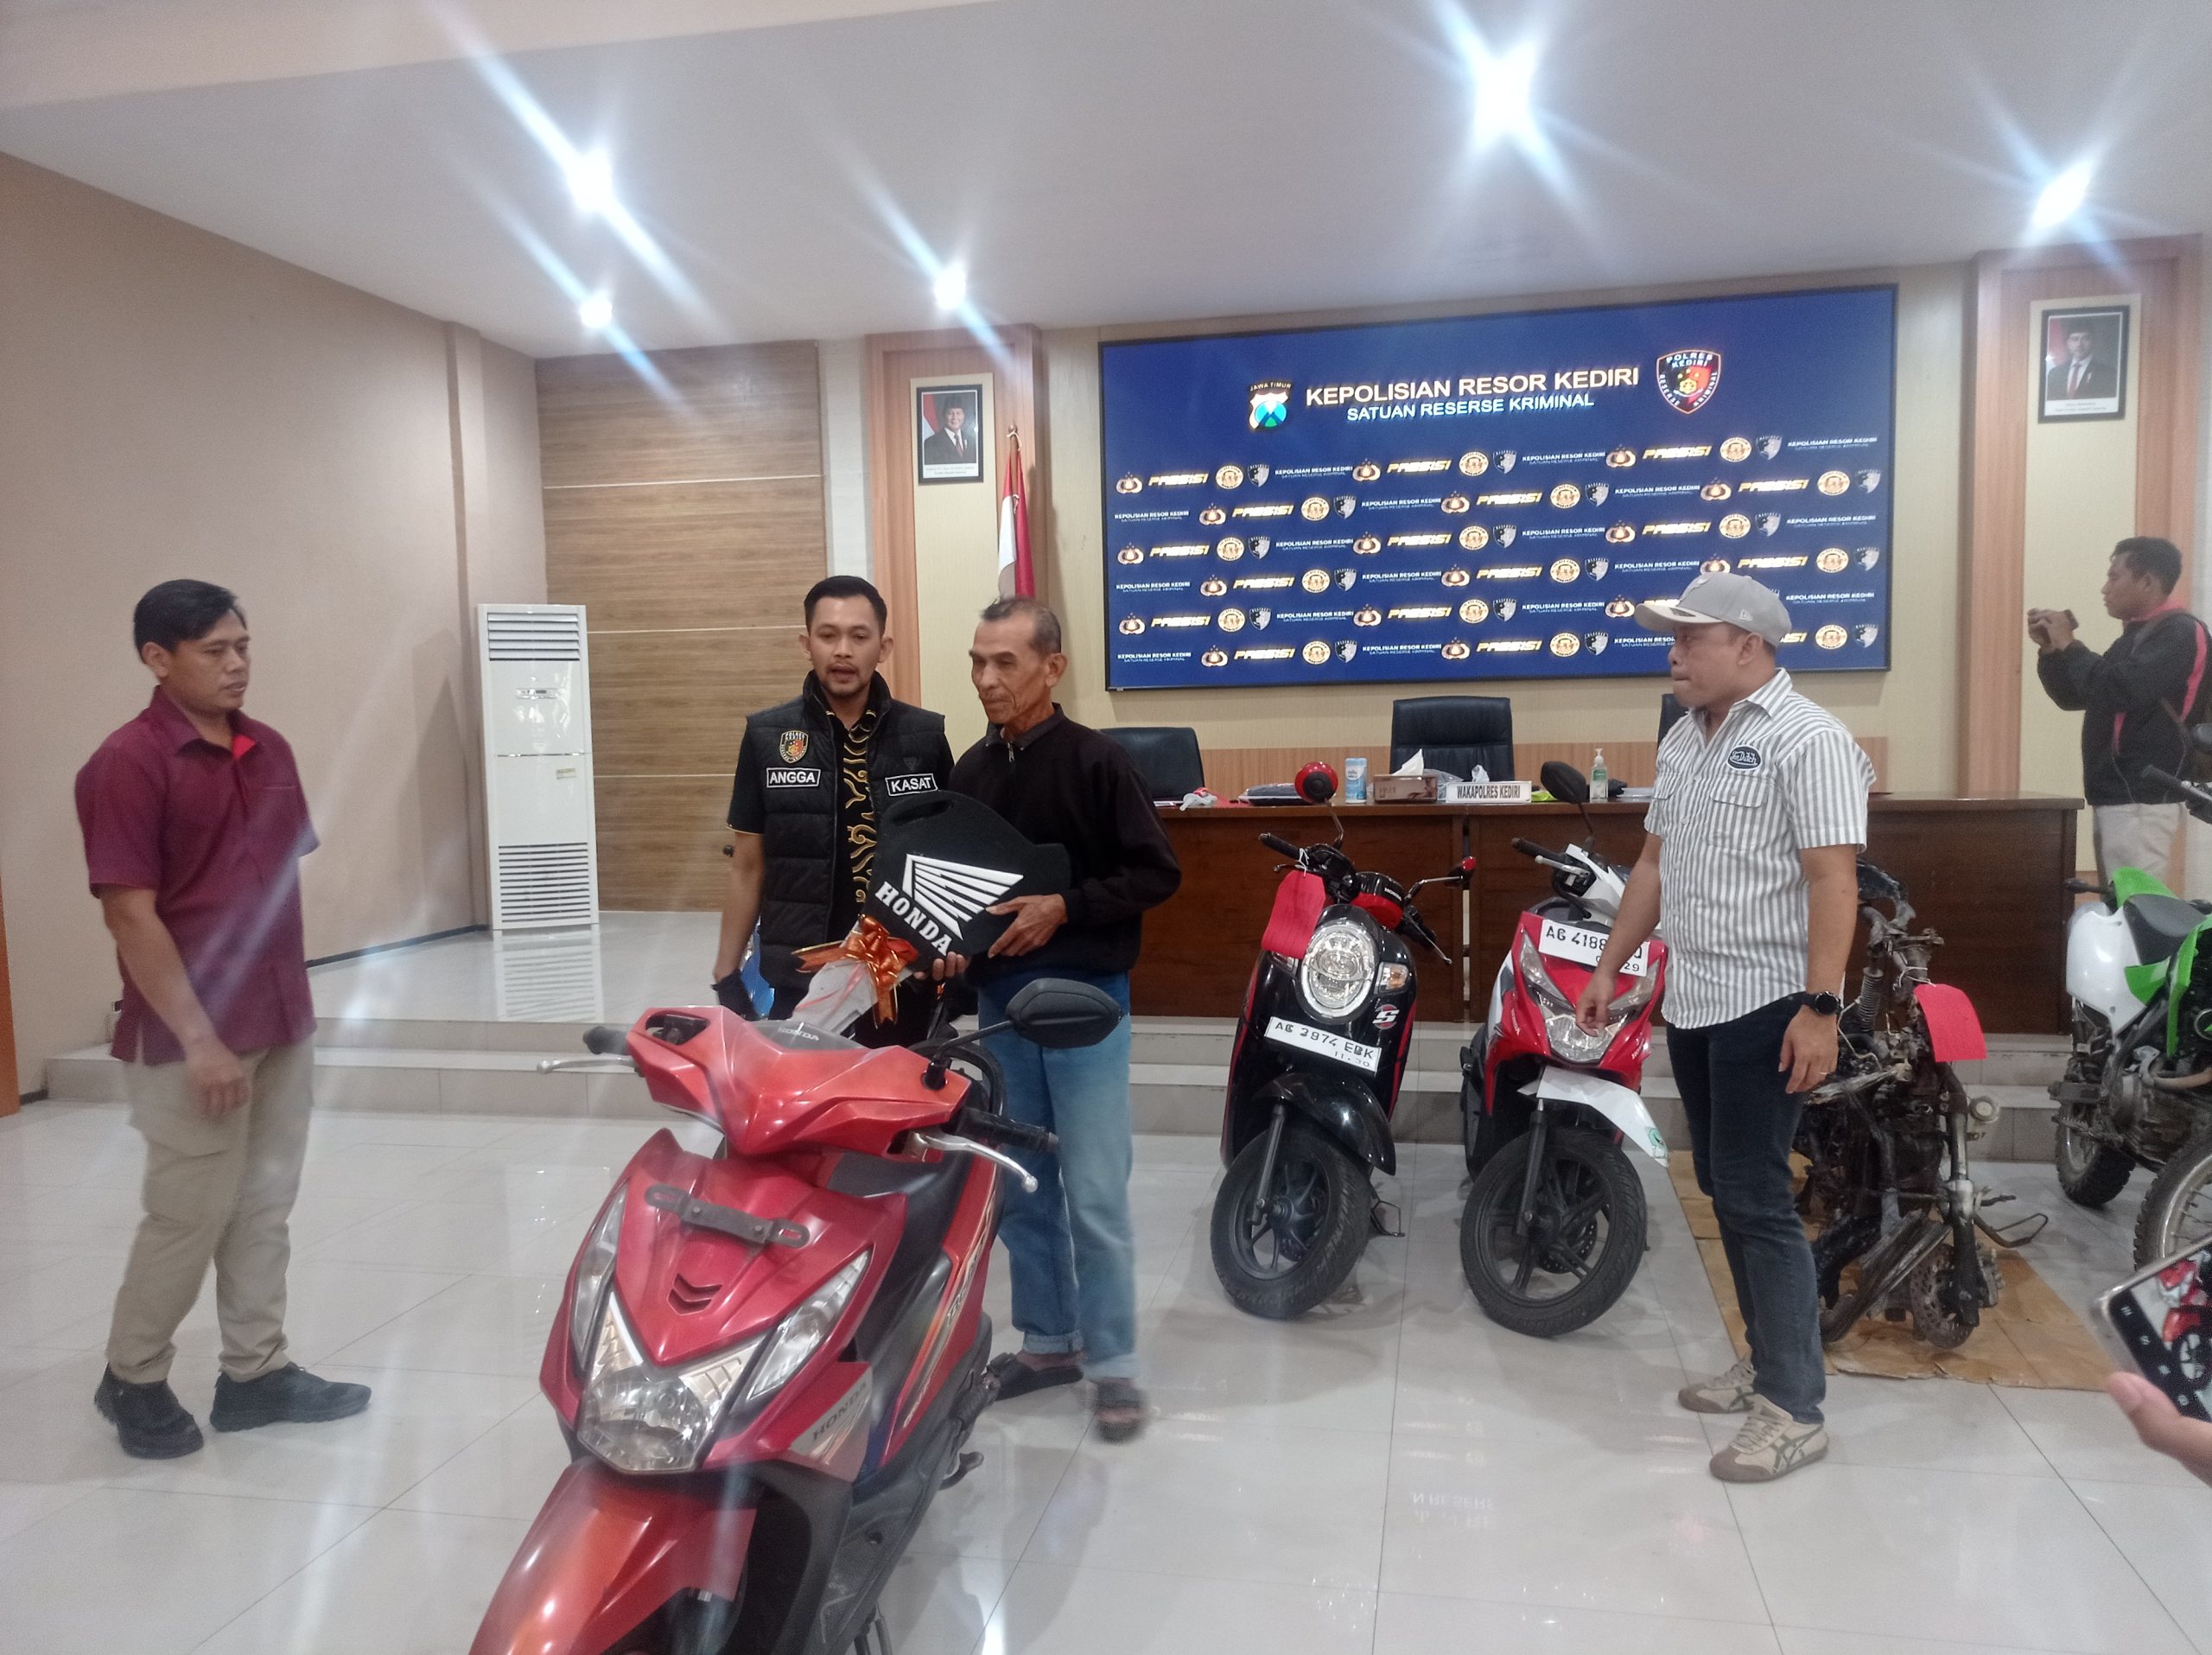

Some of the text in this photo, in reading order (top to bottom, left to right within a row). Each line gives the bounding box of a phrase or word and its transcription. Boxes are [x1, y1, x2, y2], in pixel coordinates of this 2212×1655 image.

[1306, 368, 1639, 406] KEPOLISIAN RESOR KEDIRI
[1347, 393, 1595, 422] SATUAN RESERSE KRIMINAL
[769, 771, 816, 785] ANGGA
[890, 777, 931, 792] KASAT
[1457, 785, 1521, 799] WAKAPOLRES KEDIRI
[875, 882, 952, 956] HONDA
[1546, 926, 1566, 941] AG
[1300, 1028, 1338, 1047] 3974
[1344, 1041, 1374, 1060] EBK
